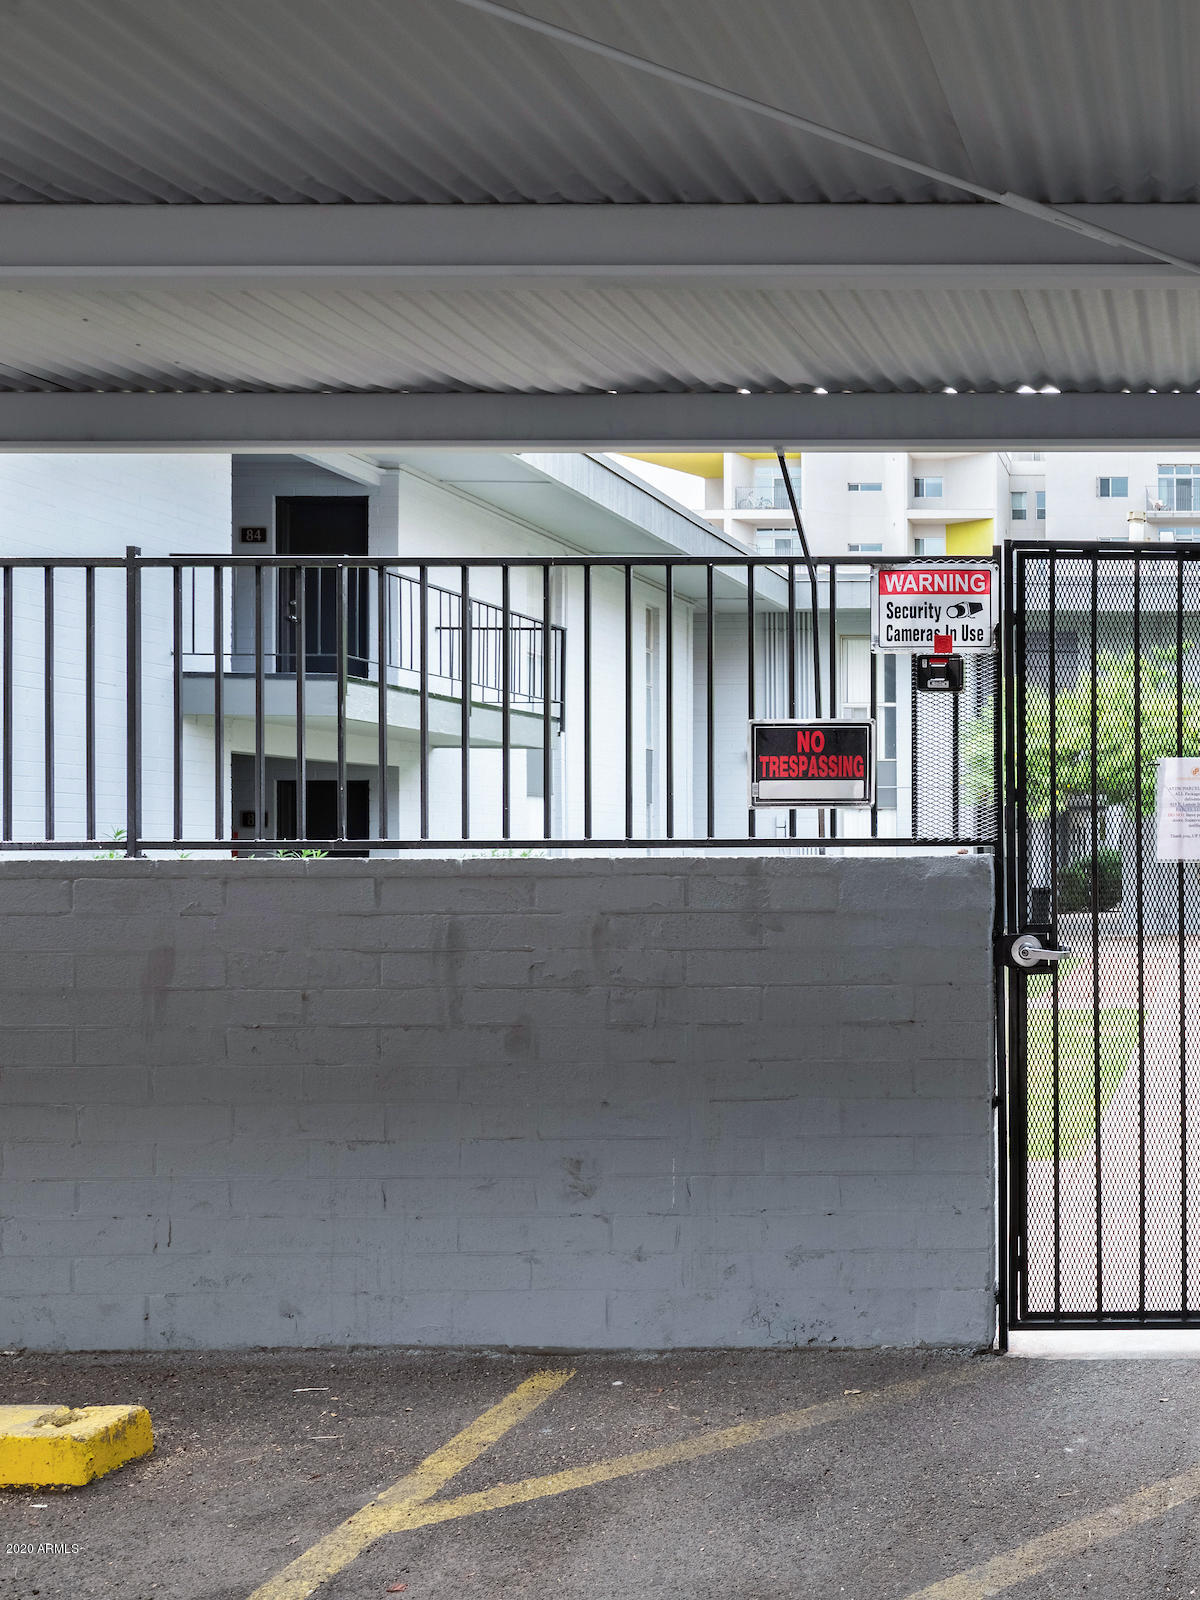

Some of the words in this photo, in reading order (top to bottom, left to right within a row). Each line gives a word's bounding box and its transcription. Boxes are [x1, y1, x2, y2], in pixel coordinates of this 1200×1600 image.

[246, 529, 262, 541] 84
[884, 574, 986, 592] WARNING
[886, 602, 942, 622] Security
[886, 624, 941, 642] Cameras
[946, 624, 957, 642] In
[961, 624, 984, 642] Use
[797, 731, 825, 753] NO
[759, 755, 865, 778] TRESPASSING
